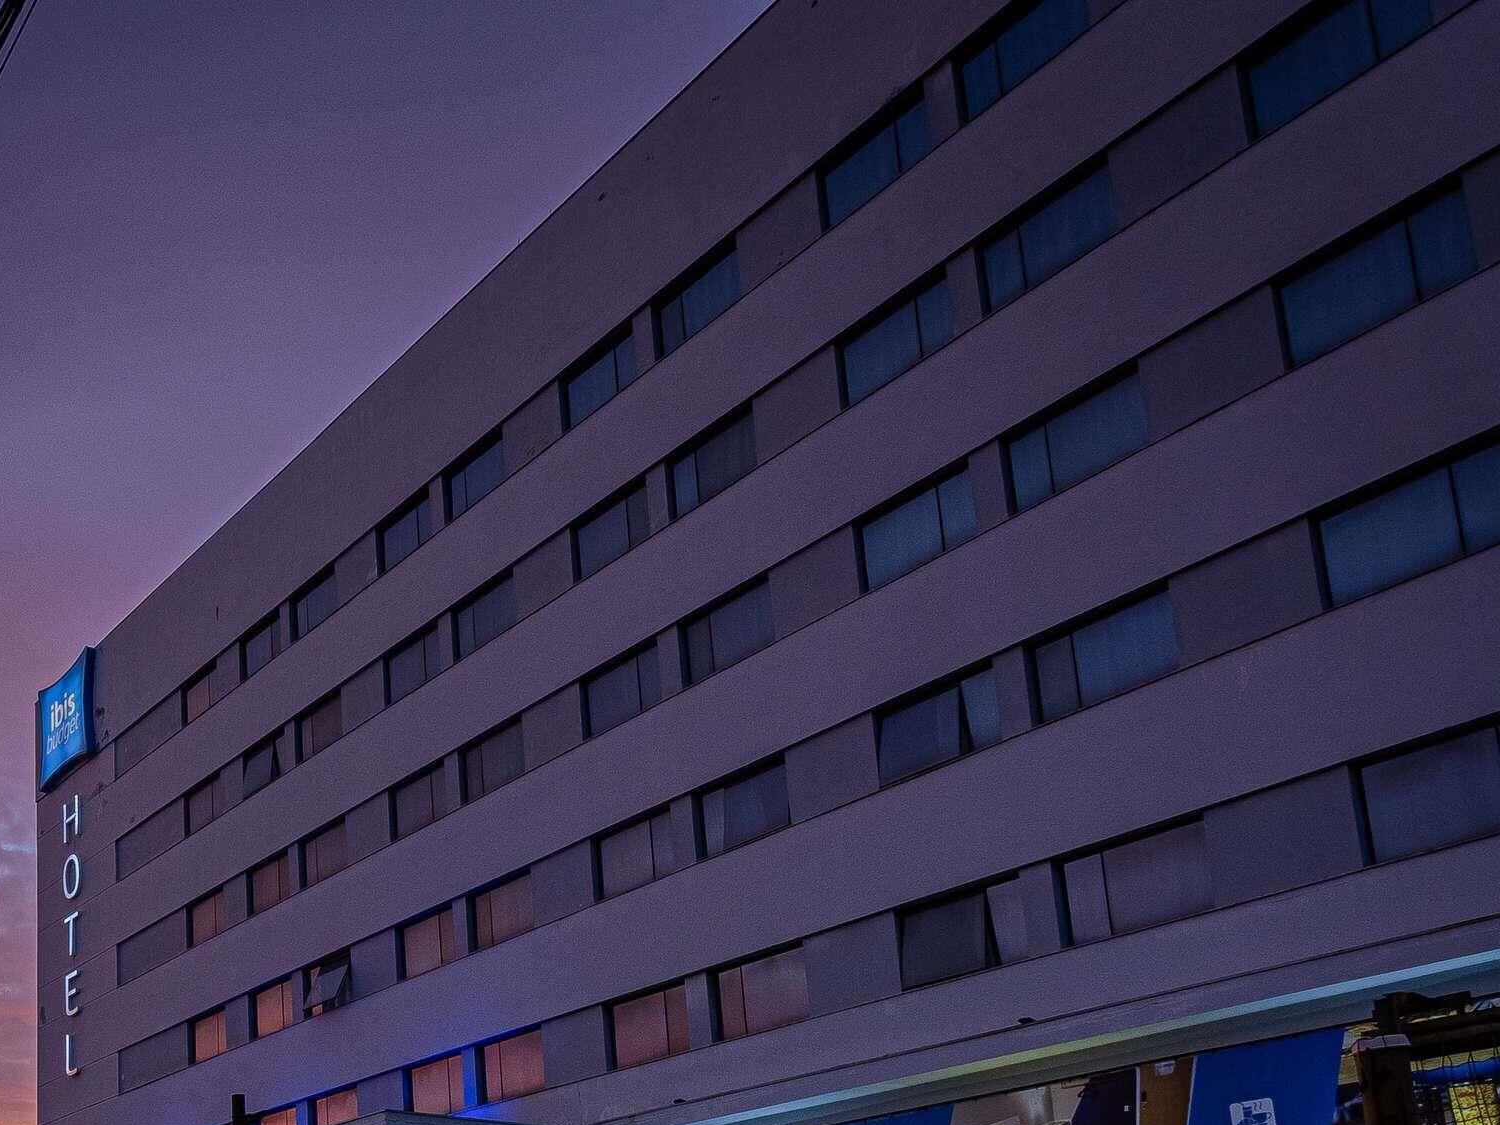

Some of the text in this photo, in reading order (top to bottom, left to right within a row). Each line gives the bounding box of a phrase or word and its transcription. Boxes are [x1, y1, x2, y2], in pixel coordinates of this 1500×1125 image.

[46, 712, 79, 755] budget
[50, 692, 75, 732] ibis
[62, 794, 81, 1077] HOTEL
